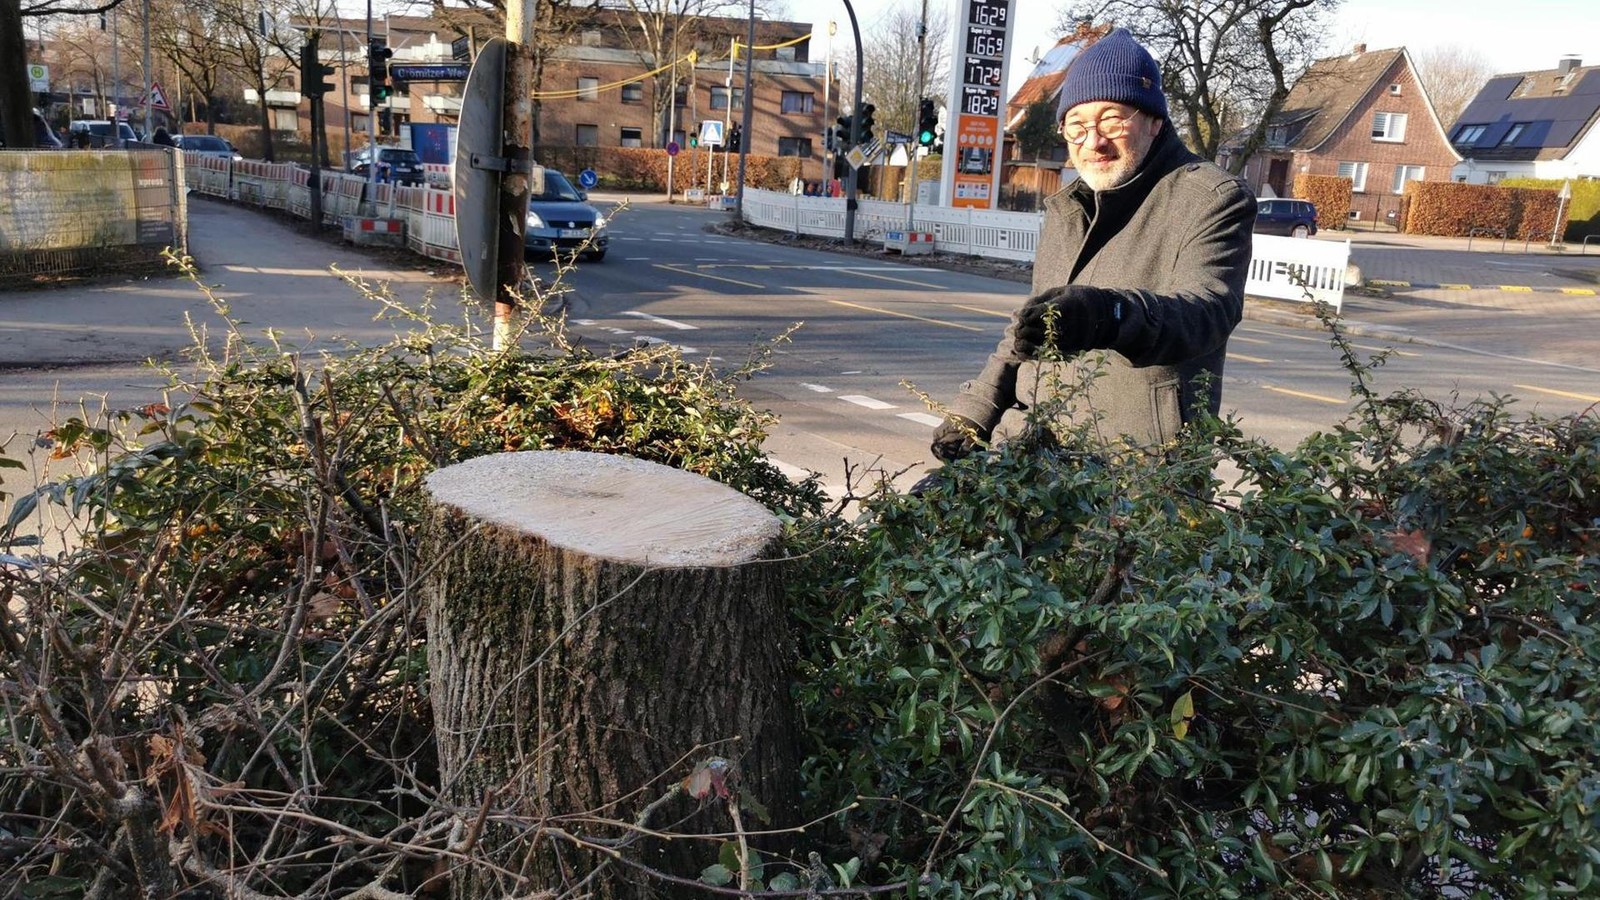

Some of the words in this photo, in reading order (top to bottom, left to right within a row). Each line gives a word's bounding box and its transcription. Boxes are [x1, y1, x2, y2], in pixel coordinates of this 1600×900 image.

[976, 5, 1006, 26] 1629
[973, 36, 1003, 56] 1669
[968, 96, 997, 115] 1829
